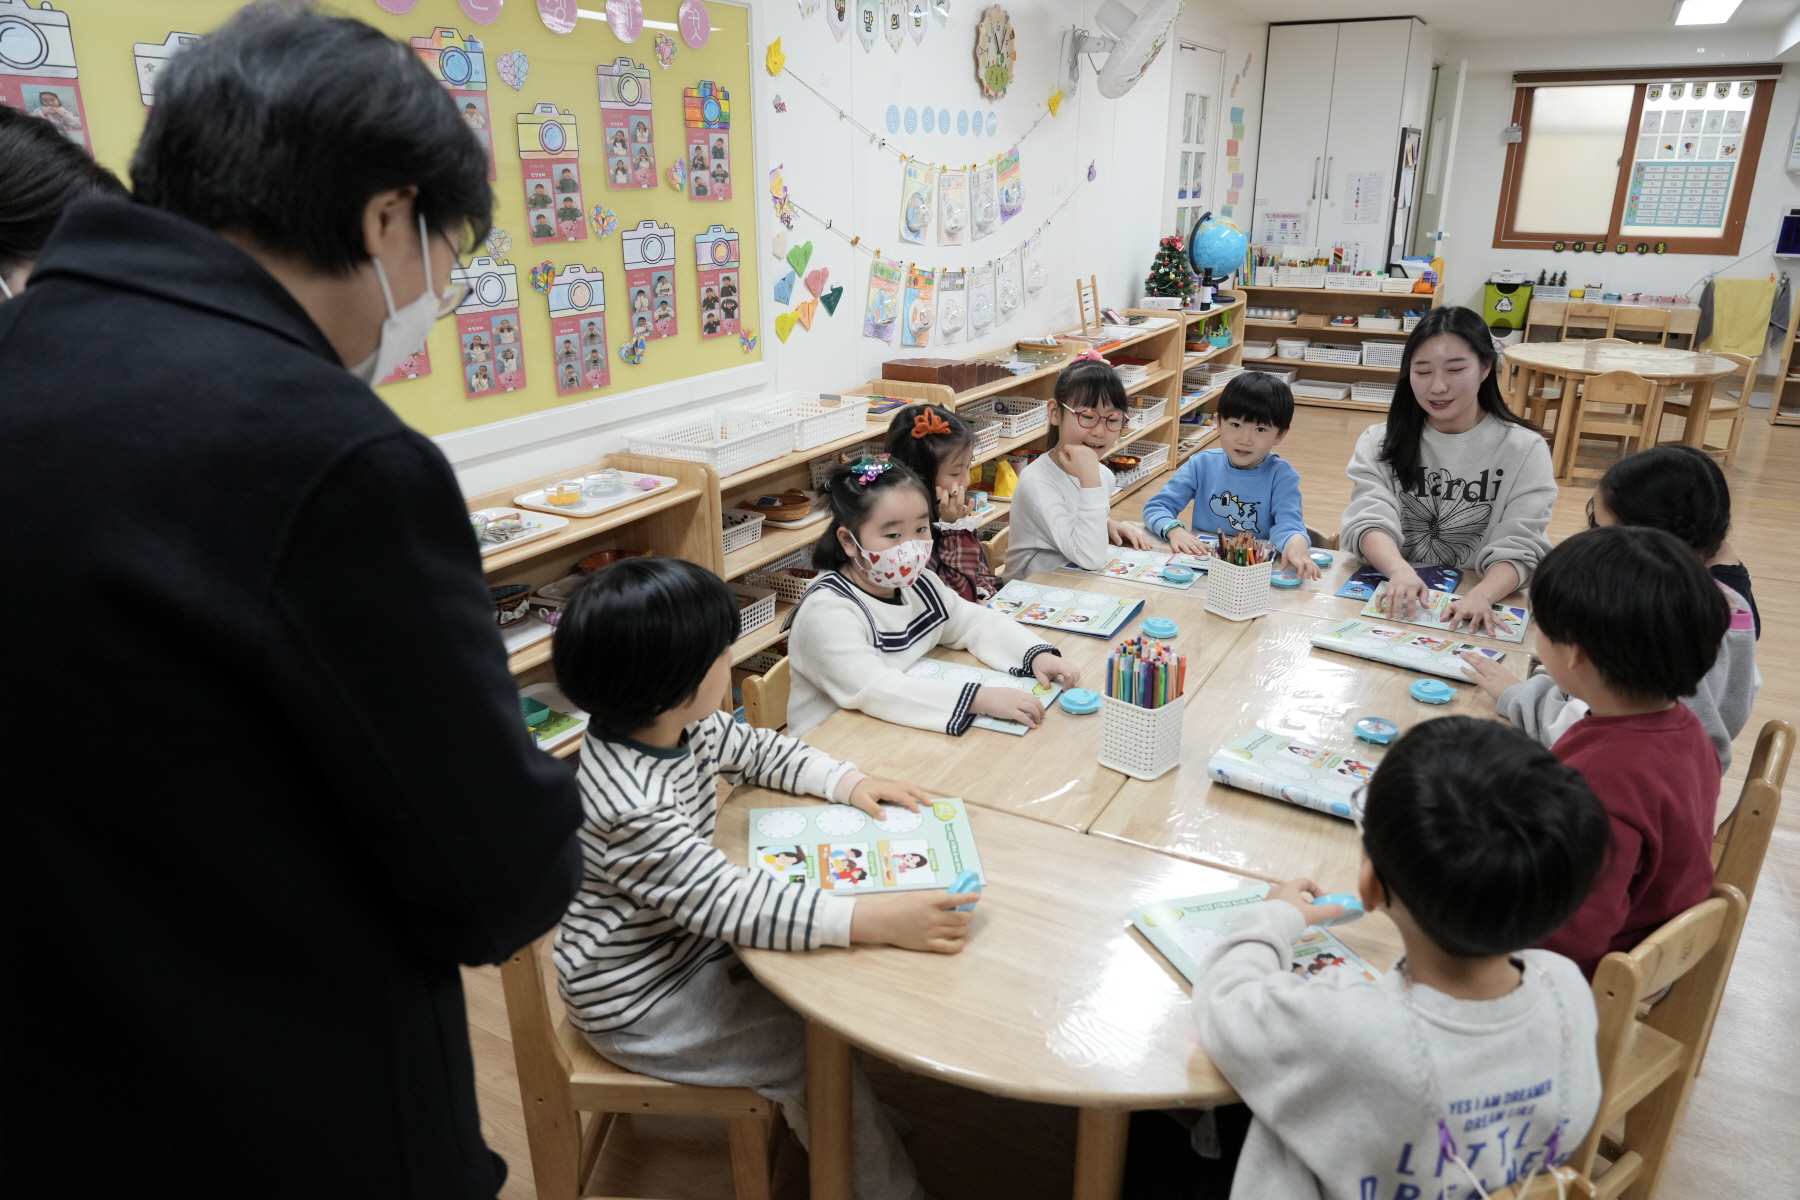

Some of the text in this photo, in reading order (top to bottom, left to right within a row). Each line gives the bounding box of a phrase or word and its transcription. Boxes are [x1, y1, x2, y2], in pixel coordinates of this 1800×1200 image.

[469, 0, 702, 42] 생네컷
[1650, 86, 1750, 98] 라이트박스
[1554, 242, 1664, 254] 라이트테이블
[1449, 1099, 1472, 1115] YES
[1475, 1098, 1479, 1111] I
[1483, 1094, 1501, 1109] AM
[1464, 1109, 1505, 1132] DREAM
